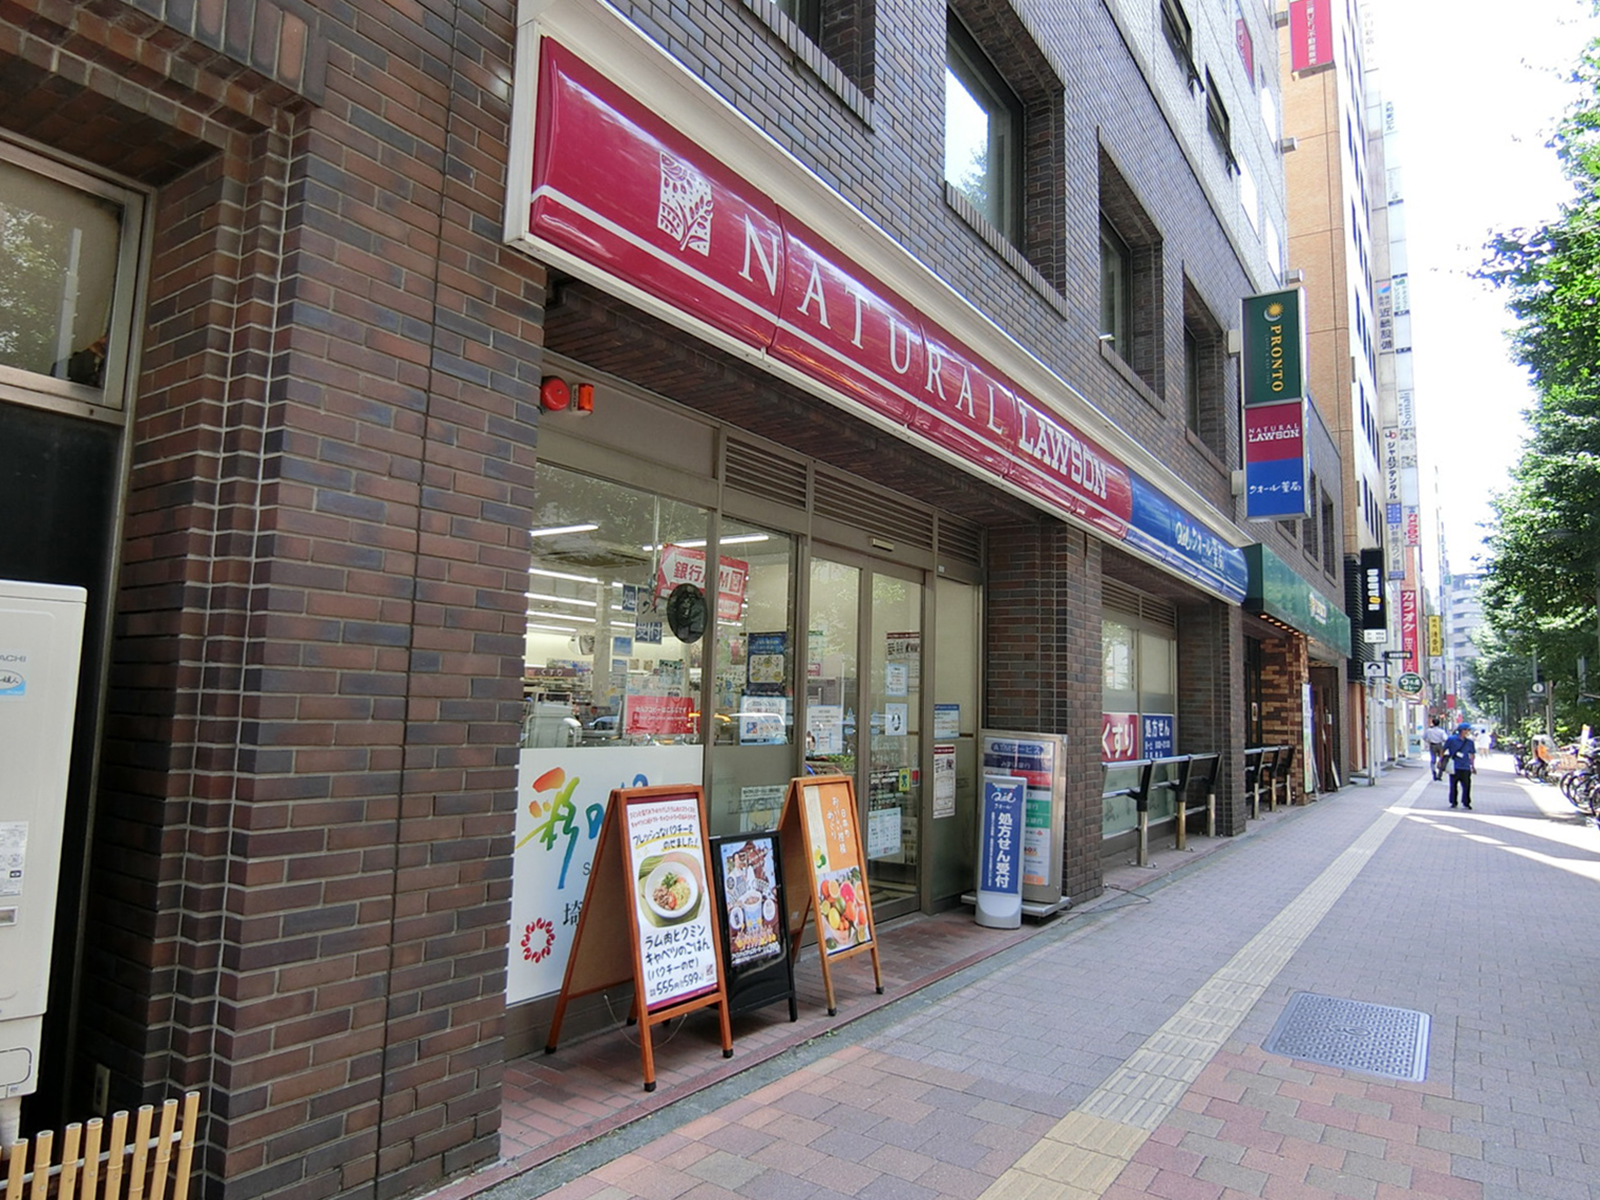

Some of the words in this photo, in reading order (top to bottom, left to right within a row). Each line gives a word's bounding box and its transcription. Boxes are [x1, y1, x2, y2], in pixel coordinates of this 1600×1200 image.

[737, 213, 1006, 437] NATURAL
[1016, 402, 1109, 500] LAWSON
[1270, 324, 1284, 392] PRONTO
[1248, 422, 1299, 434] NATURAL
[1248, 428, 1300, 443] LAWSON
[1366, 568, 1382, 612] DOUTOR
[1403, 591, 1416, 633] カラオケ
[1102, 722, 1134, 760] くすり
[995, 811, 1013, 889] 処方せん受付
[644, 924, 706, 951] ラム肉とクミン
[645, 938, 711, 966] キャベツのごはん
